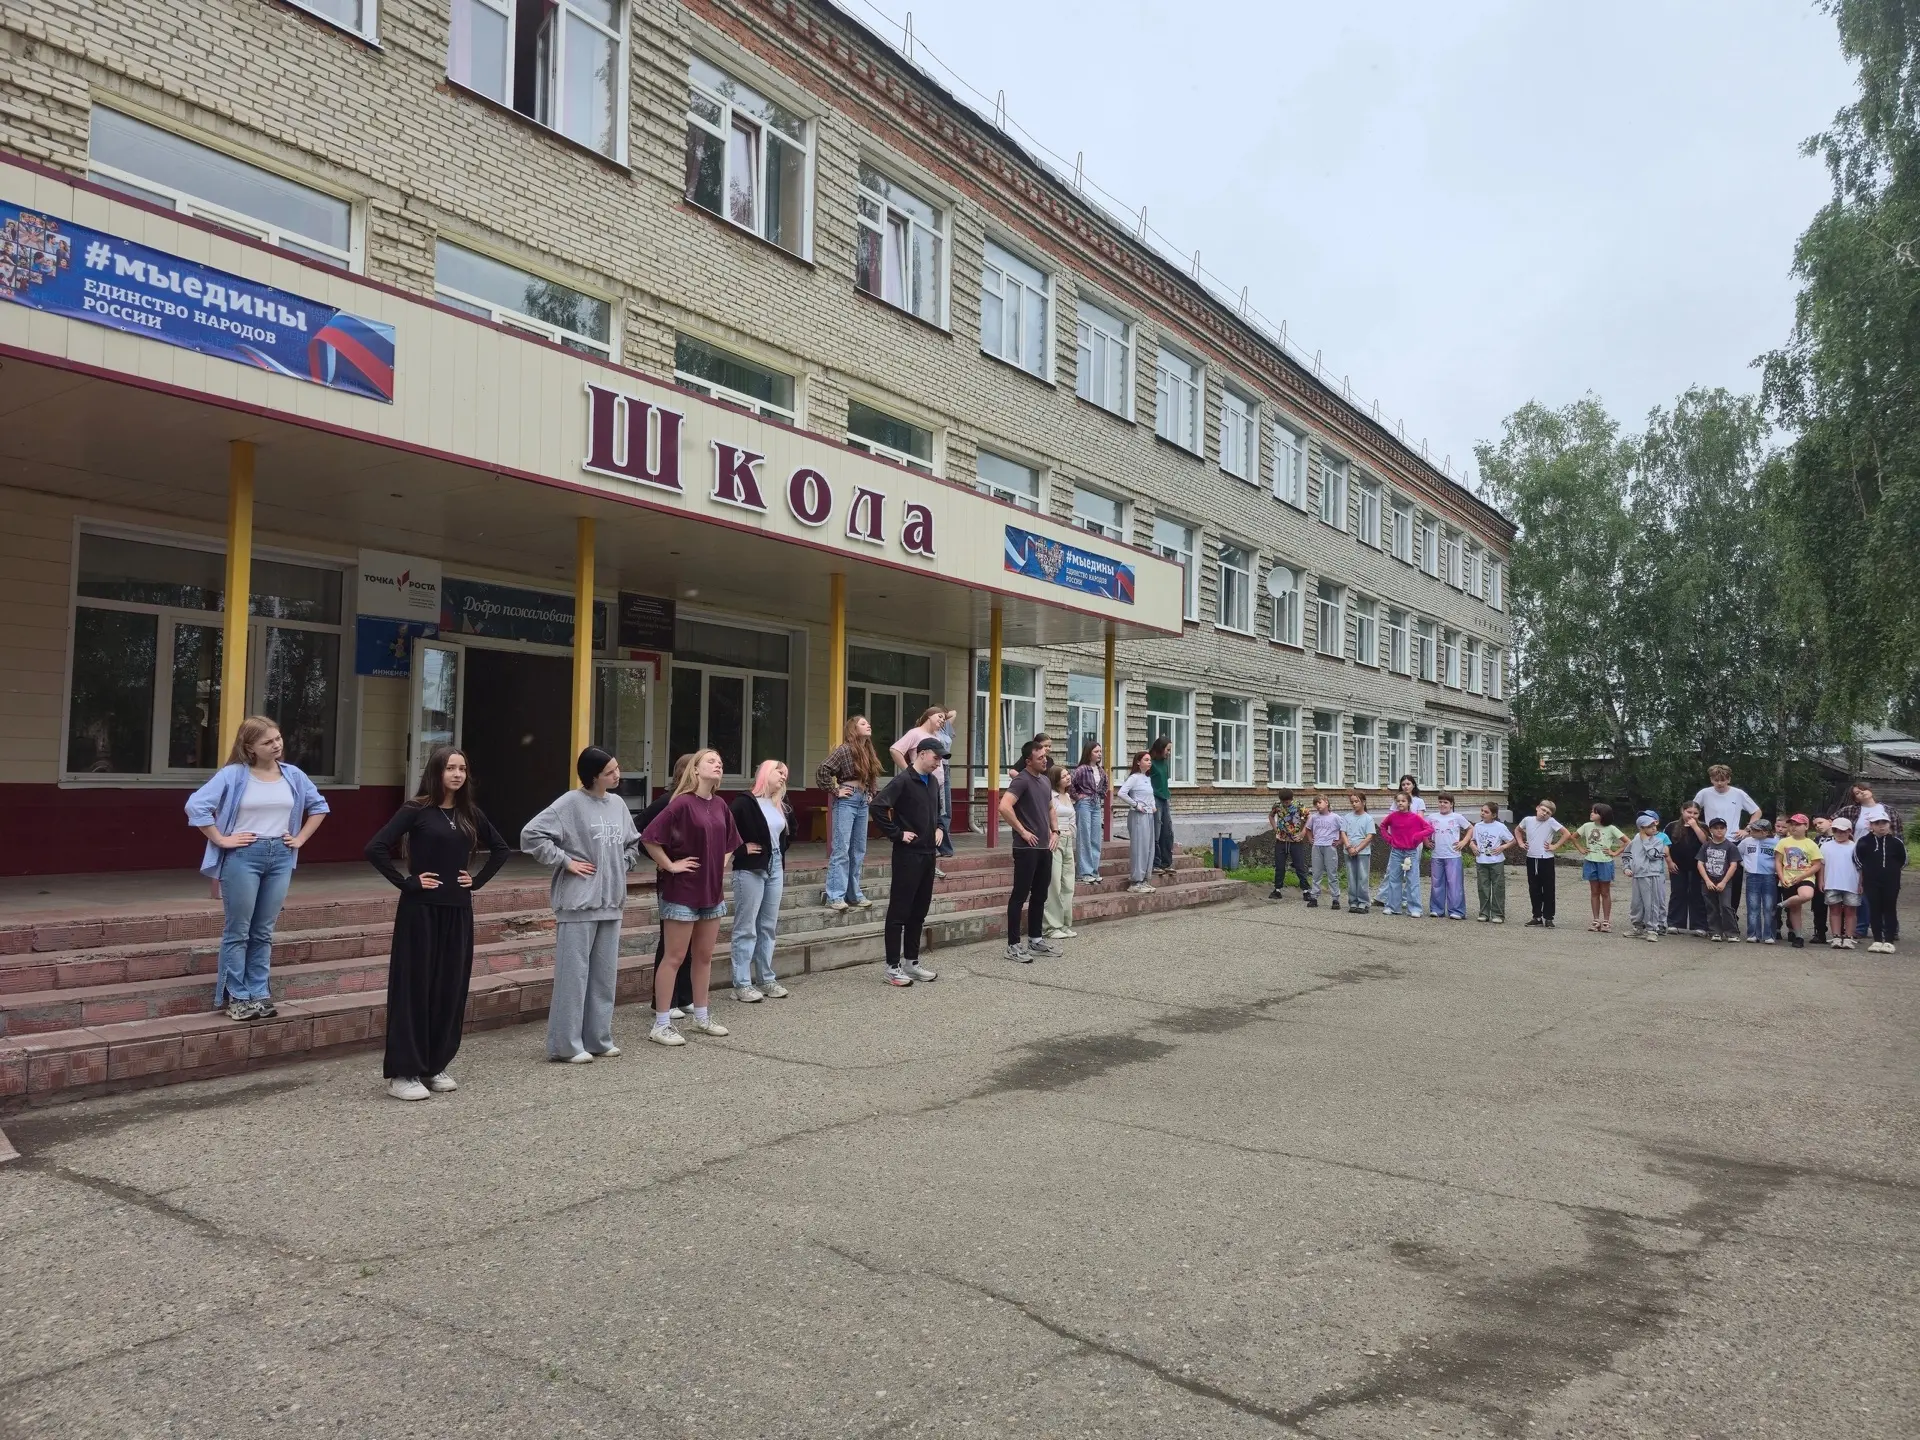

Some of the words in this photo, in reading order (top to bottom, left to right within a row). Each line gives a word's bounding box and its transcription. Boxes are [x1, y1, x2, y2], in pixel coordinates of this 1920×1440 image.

[84, 240, 309, 332] #мыедины
[82, 295, 163, 330] РОССИИ
[83, 278, 189, 320] ЕДИНСТВО
[193, 309, 278, 345] НАРОДОВ
[582, 380, 937, 559] Школа
[1066, 551, 1114, 576] #мыедины
[364, 574, 395, 586] ТОЧКА
[408, 580, 436, 591] РОСТА
[462, 595, 501, 620] Добро
